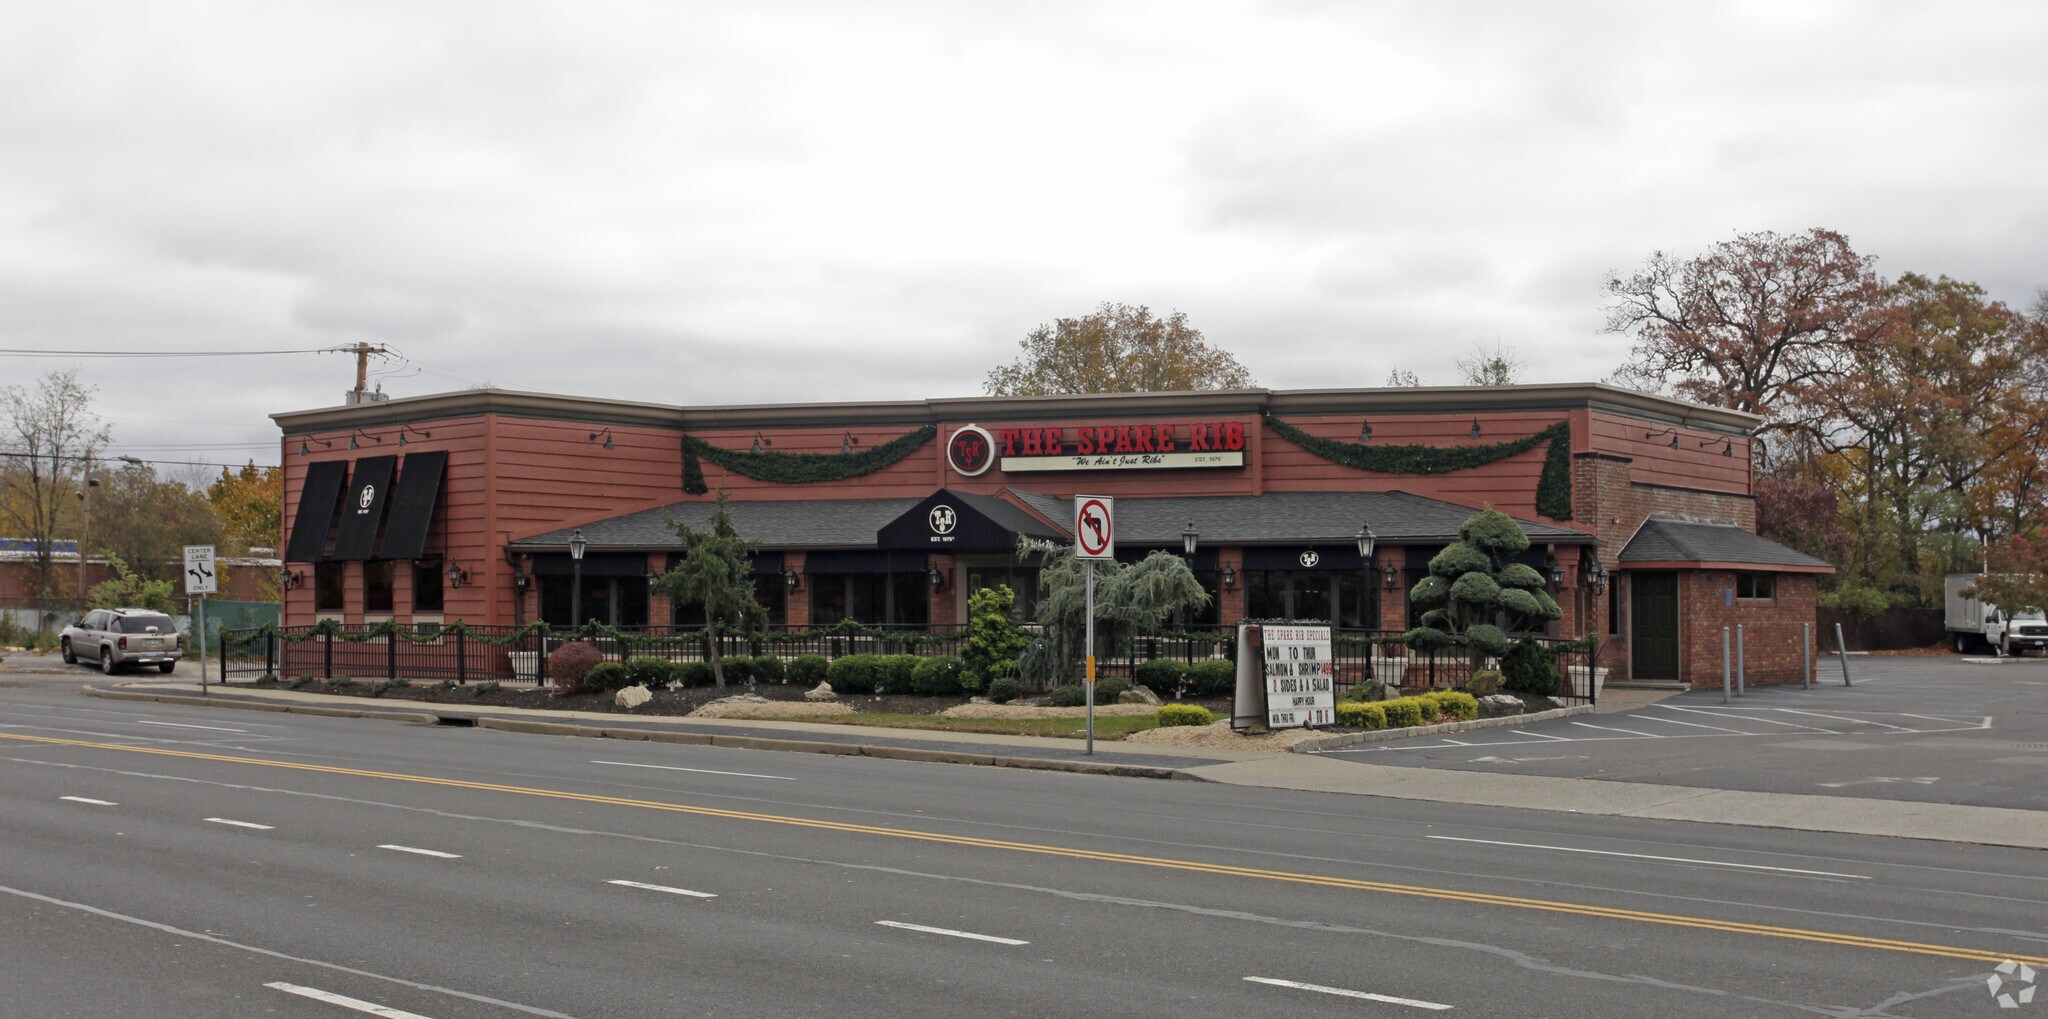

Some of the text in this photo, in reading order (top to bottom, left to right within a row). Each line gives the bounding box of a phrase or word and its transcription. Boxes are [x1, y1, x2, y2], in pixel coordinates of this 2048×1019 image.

[1000, 422, 1244, 456] THE SPARE RIB
[1094, 455, 1117, 466] Ain't
[1118, 456, 1139, 467] Just
[1263, 629, 1330, 641] THE SPARE RIB SPECIALS
[1266, 646, 1316, 660] MON TO THUR
[1265, 662, 1288, 677] SALMON
[1288, 662, 1294, 676] &
[1298, 662, 1320, 676] SHRIMP
[1272, 678, 1330, 693] 2 SIDES & A SALAD
[1292, 696, 1315, 706] HAPPY HOUR
[1315, 710, 1323, 723] TO
